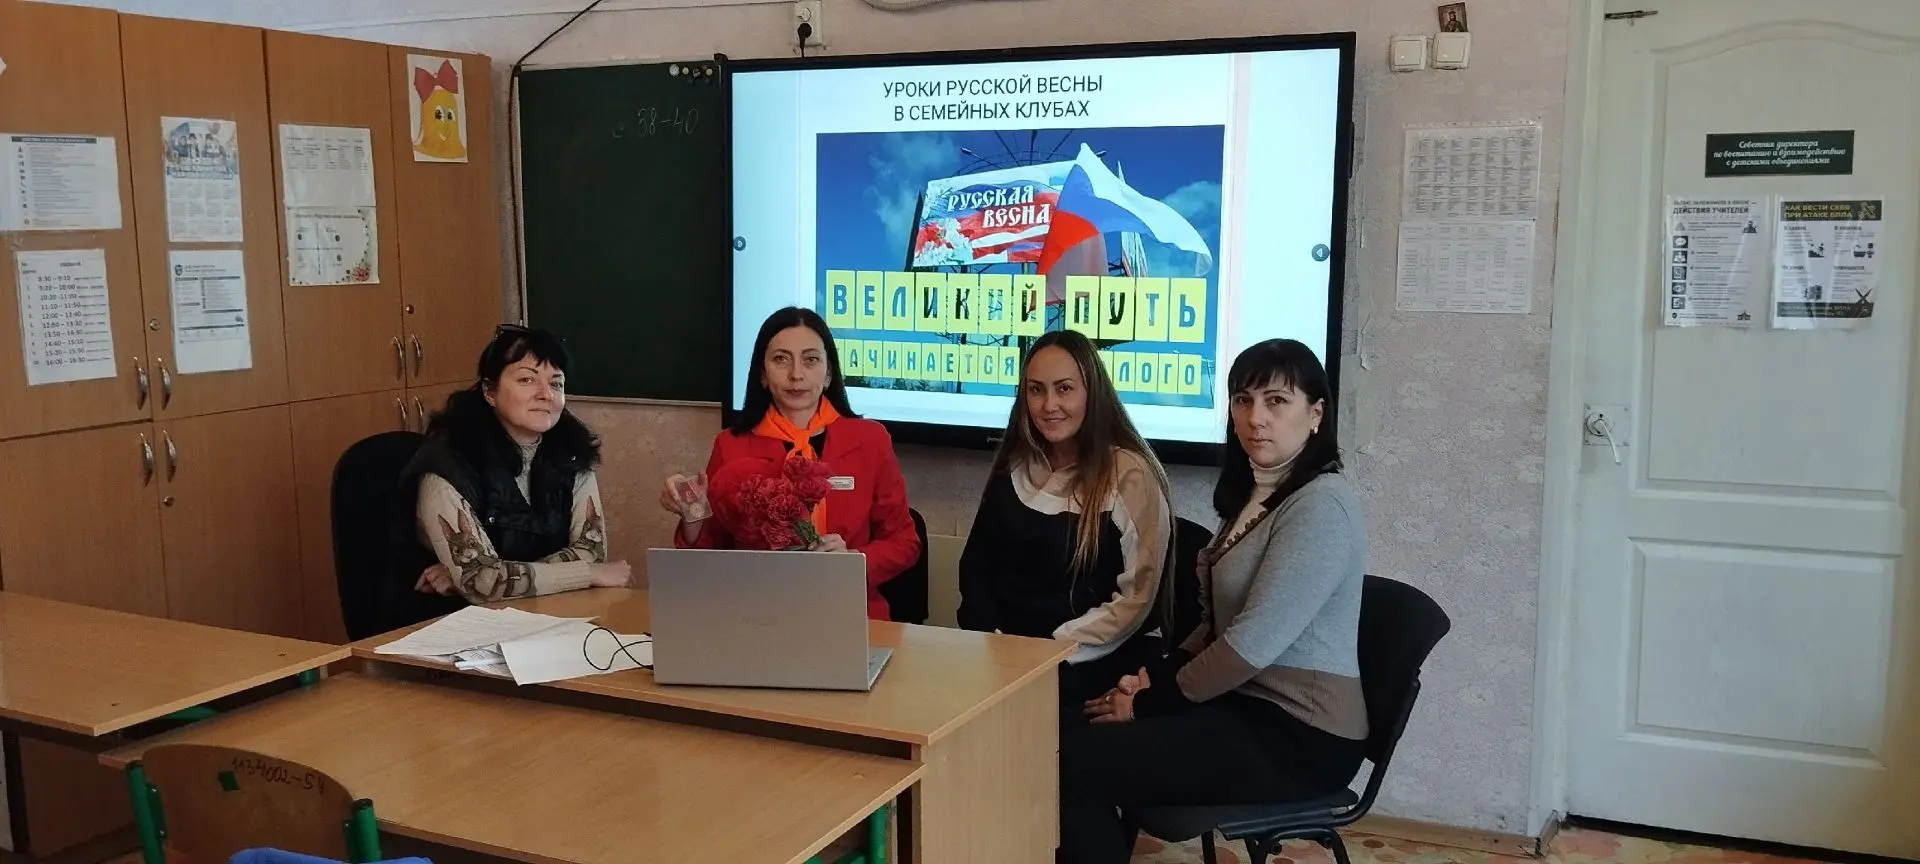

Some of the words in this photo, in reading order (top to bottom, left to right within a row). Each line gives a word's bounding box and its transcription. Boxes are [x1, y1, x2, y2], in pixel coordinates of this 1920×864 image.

[883, 81, 941, 98] УРОКИ
[946, 74, 1031, 96] РУССКОЙ
[1037, 74, 1102, 94] ВЕСНЫ
[894, 106, 904, 121] В
[909, 100, 1010, 120] СЕМЕЙНЫХ
[1015, 100, 1090, 118] КЛУБАХ
[947, 184, 1034, 212] РУССКАЯ
[1673, 206, 1710, 215] ДЕЙСТВИЯ
[1712, 205, 1749, 214] УЧИТЕЛЕЙ
[982, 203, 1051, 228] ВЕСНА
[833, 283, 1037, 322] ВЕЛИКИЙ
[1074, 291, 1196, 328] ПУТЬ
[836, 347, 1015, 377] АЧИНАЕТСЯ
